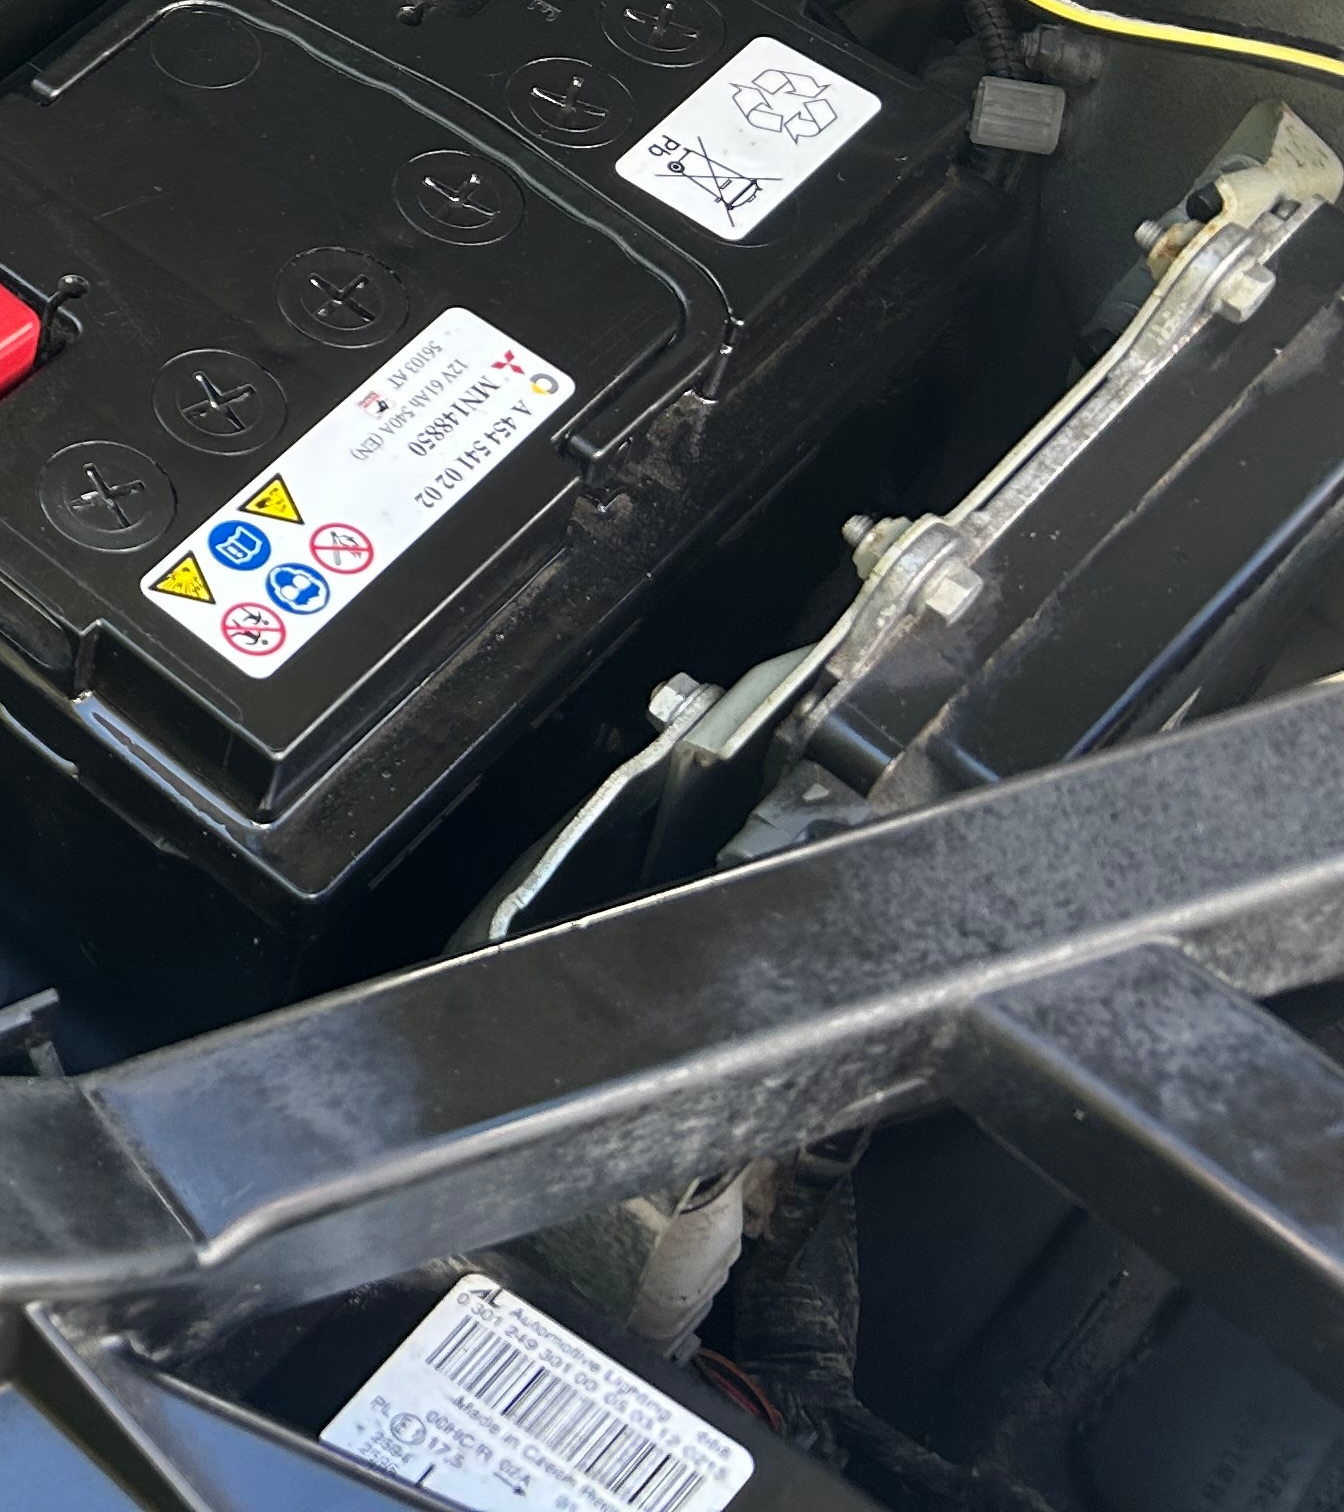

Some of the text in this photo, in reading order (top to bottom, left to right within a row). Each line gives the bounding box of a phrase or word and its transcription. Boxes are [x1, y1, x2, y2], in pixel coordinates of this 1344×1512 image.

[648, 134, 681, 157] Pb
[383, 339, 444, 390] 56103 AT
[439, 359, 468, 385] 12V
[409, 379, 446, 414] 61Ah
[377, 405, 412, 439] 540A
[407, 374, 501, 458] MN148850
[350, 432, 385, 462] (EN)
[414, 399, 533, 509] A 454 541 02 02
[470, 1300, 504, 1327] 301
